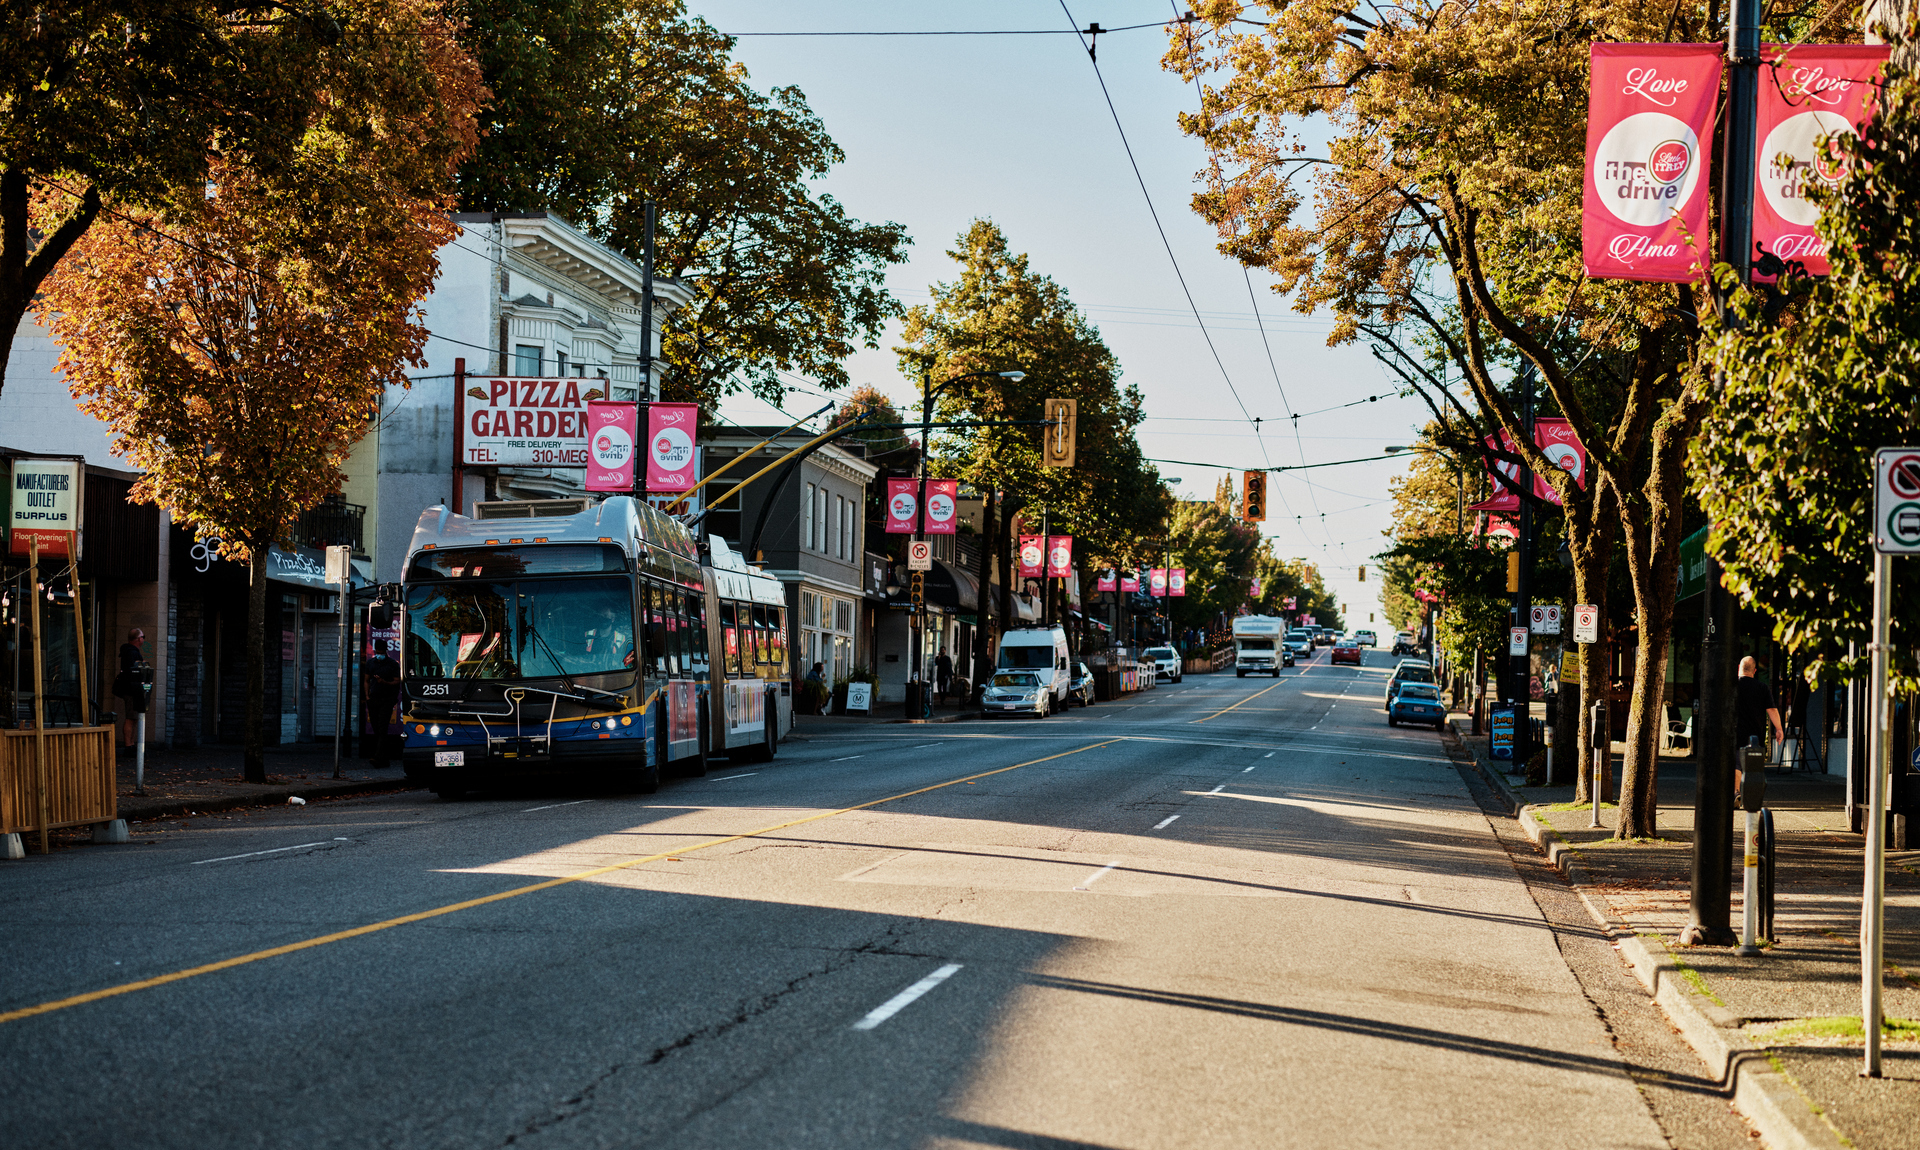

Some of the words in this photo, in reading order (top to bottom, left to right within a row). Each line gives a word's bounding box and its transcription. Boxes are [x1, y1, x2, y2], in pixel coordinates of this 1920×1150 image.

[1622, 67, 1688, 106] Love
[1788, 66, 1853, 105] Love
[1658, 150, 1685, 163] Little
[1606, 161, 1646, 181] the
[1654, 160, 1685, 172] ITALY
[1618, 180, 1678, 200] drive
[1608, 234, 1678, 264] Ama
[1772, 234, 1828, 260] Am
[489, 380, 582, 408] PIZZA
[1547, 426, 1574, 442] Love
[468, 449, 497, 462] TEL:
[532, 450, 588, 463] 310-MEG
[16, 473, 69, 490] MANUFACTURERS
[28, 492, 56, 507] OUTLET
[15, 512, 67, 520] SURPLUS
[1708, 617, 1713, 626] 3
[1707, 625, 1715, 634] 10
[373, 639, 400, 651] LSS
[422, 684, 449, 696] 2551
